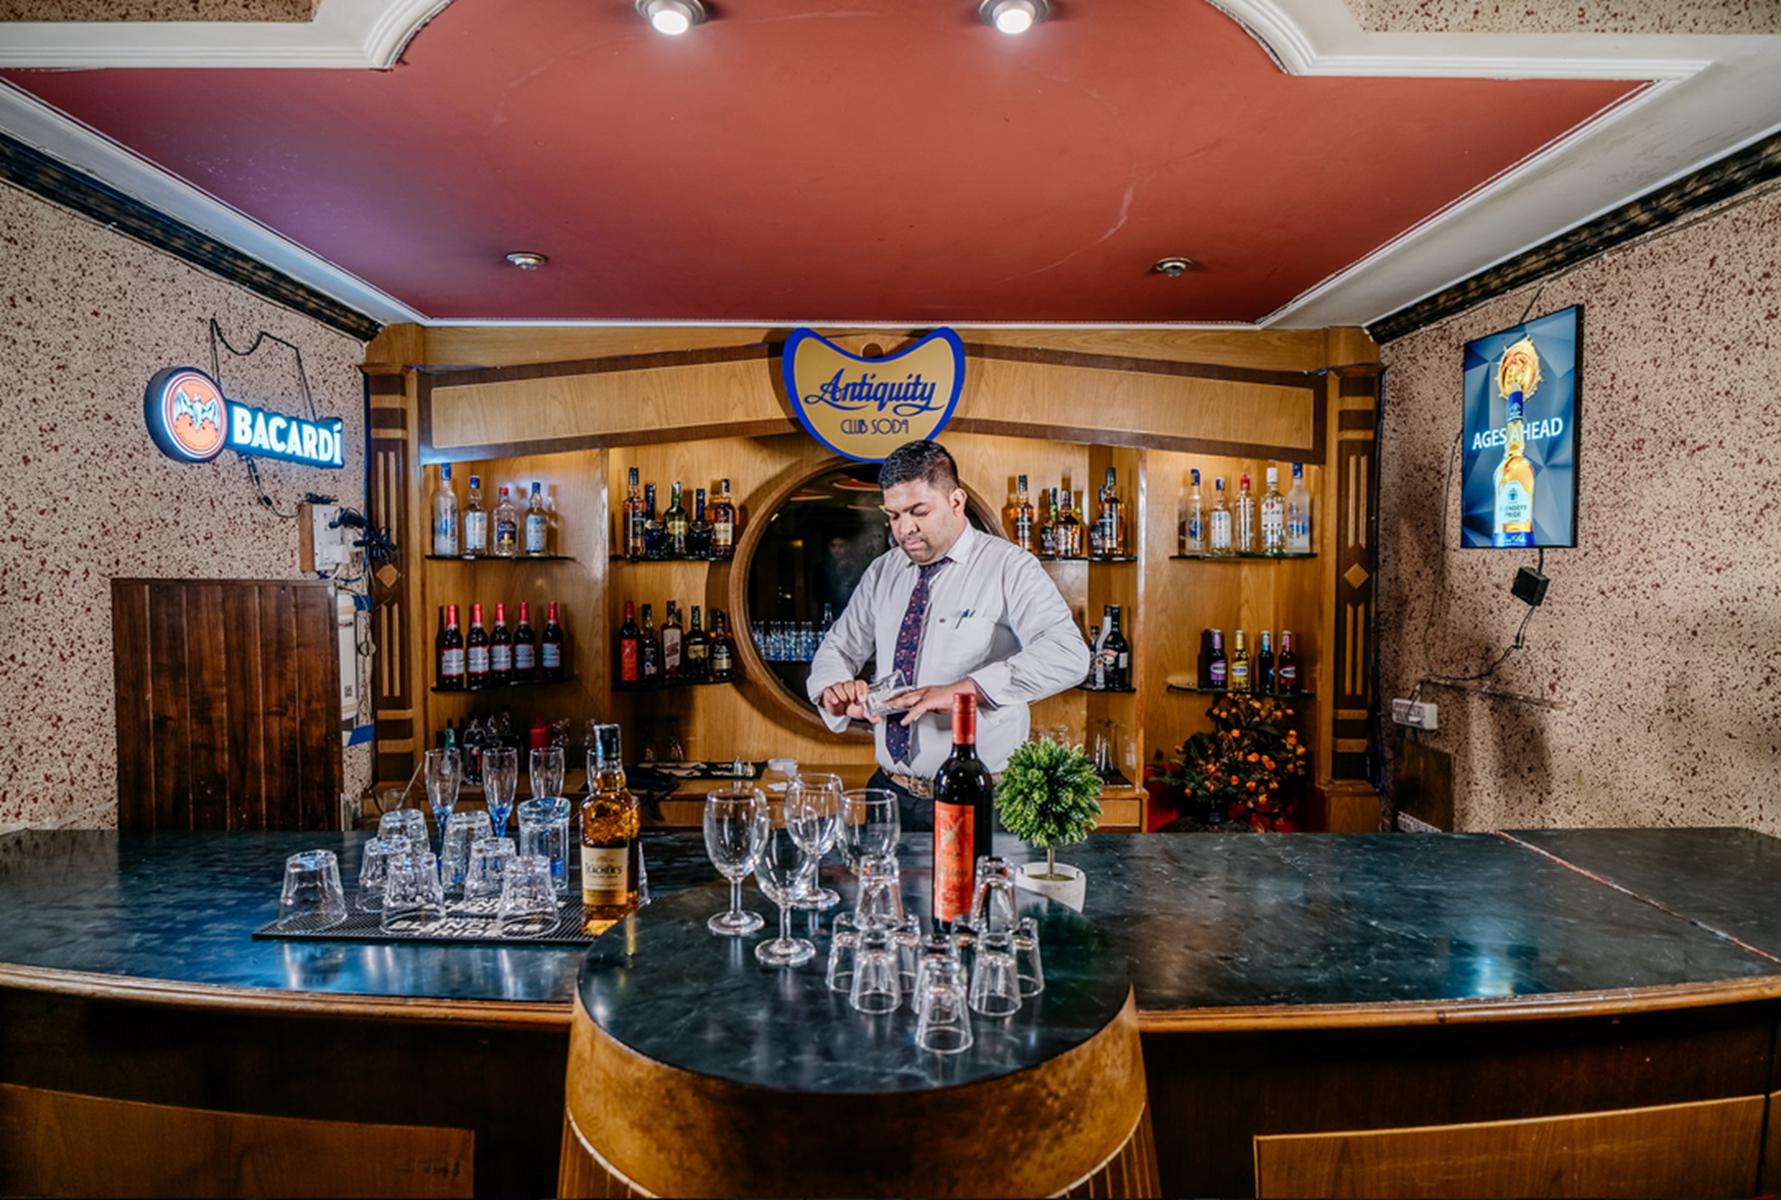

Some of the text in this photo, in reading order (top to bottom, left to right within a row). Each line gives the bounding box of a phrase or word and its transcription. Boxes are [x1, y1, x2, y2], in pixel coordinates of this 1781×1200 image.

[804, 367, 945, 417] Antiquity
[232, 405, 343, 465] BACARDÍ
[840, 418, 909, 435] CLUB SODA
[1472, 417, 1563, 450] AGES AHEAD
[1499, 504, 1527, 513] BENDERS
